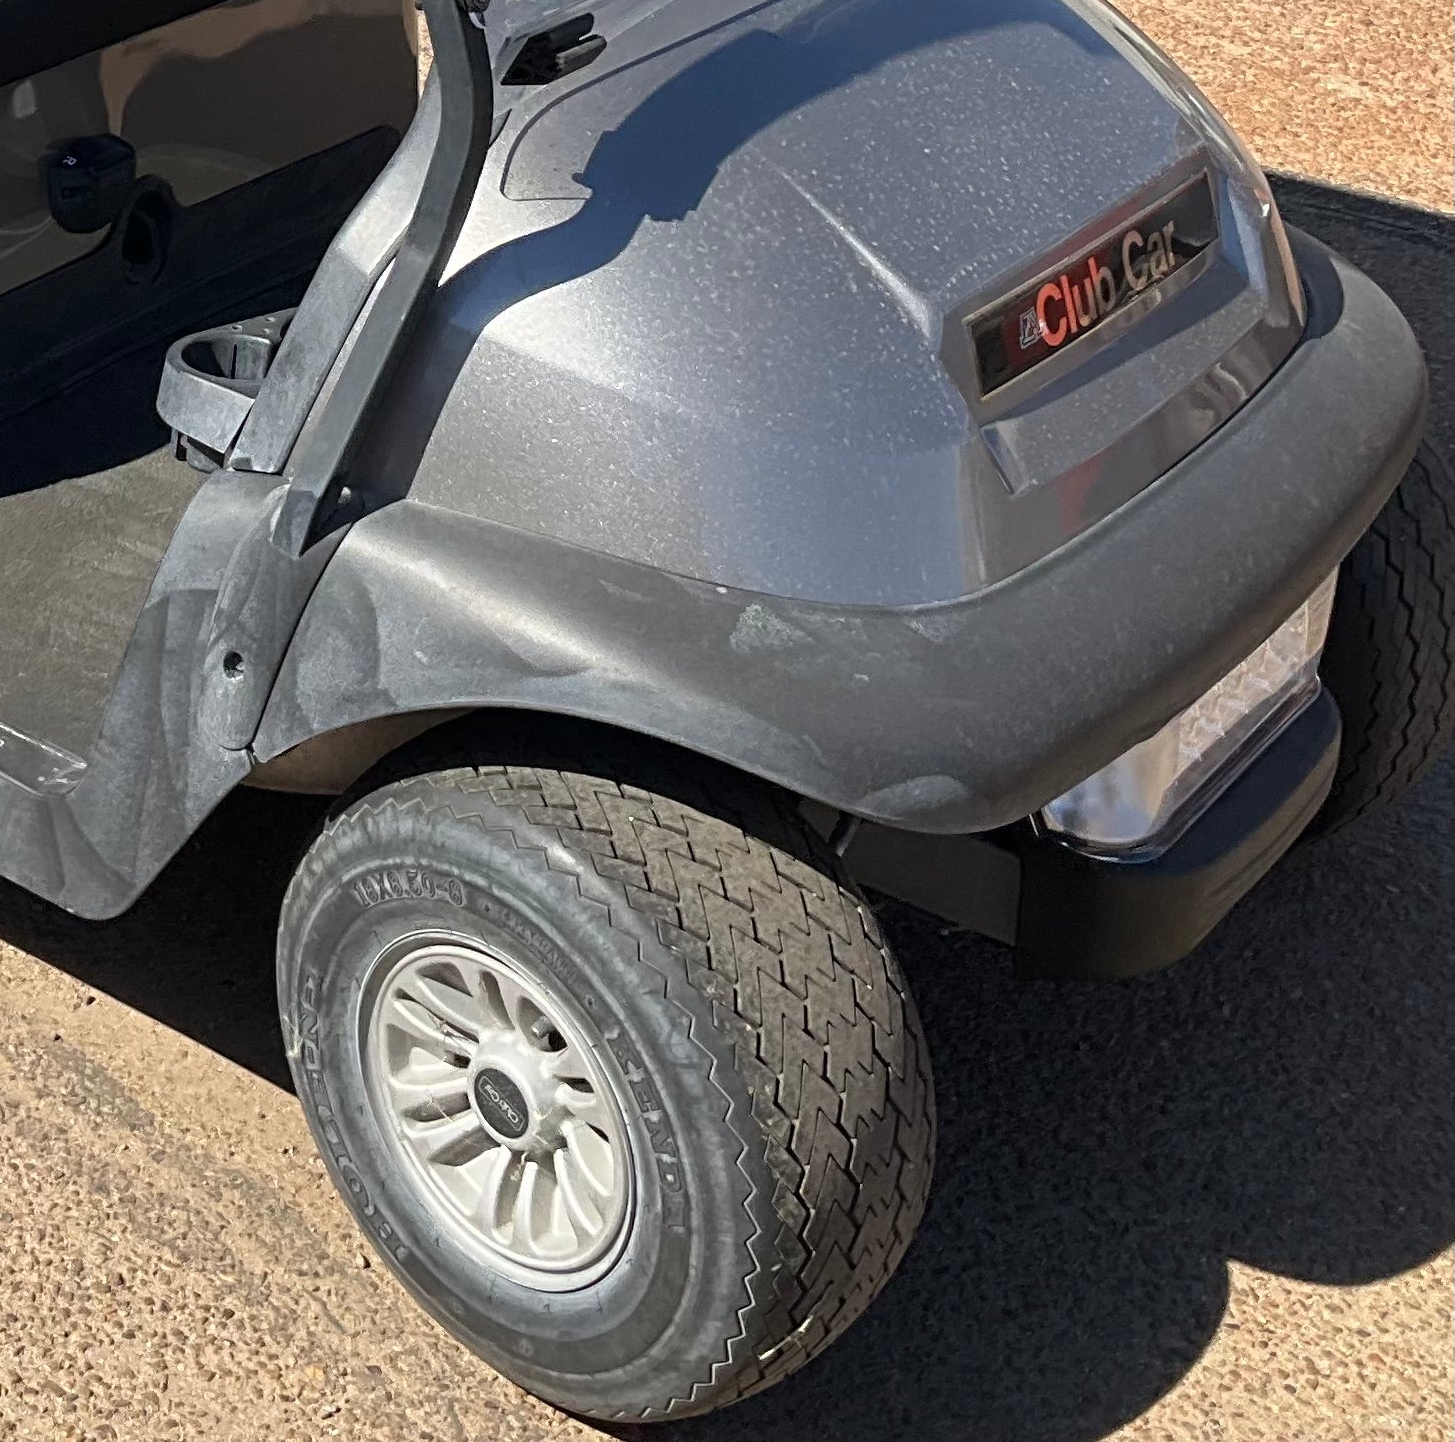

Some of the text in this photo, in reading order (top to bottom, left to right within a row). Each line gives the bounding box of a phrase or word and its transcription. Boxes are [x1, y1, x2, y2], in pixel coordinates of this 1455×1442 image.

[1036, 220, 1176, 347] Club Car
[606, 1034, 688, 1232] KENDA
